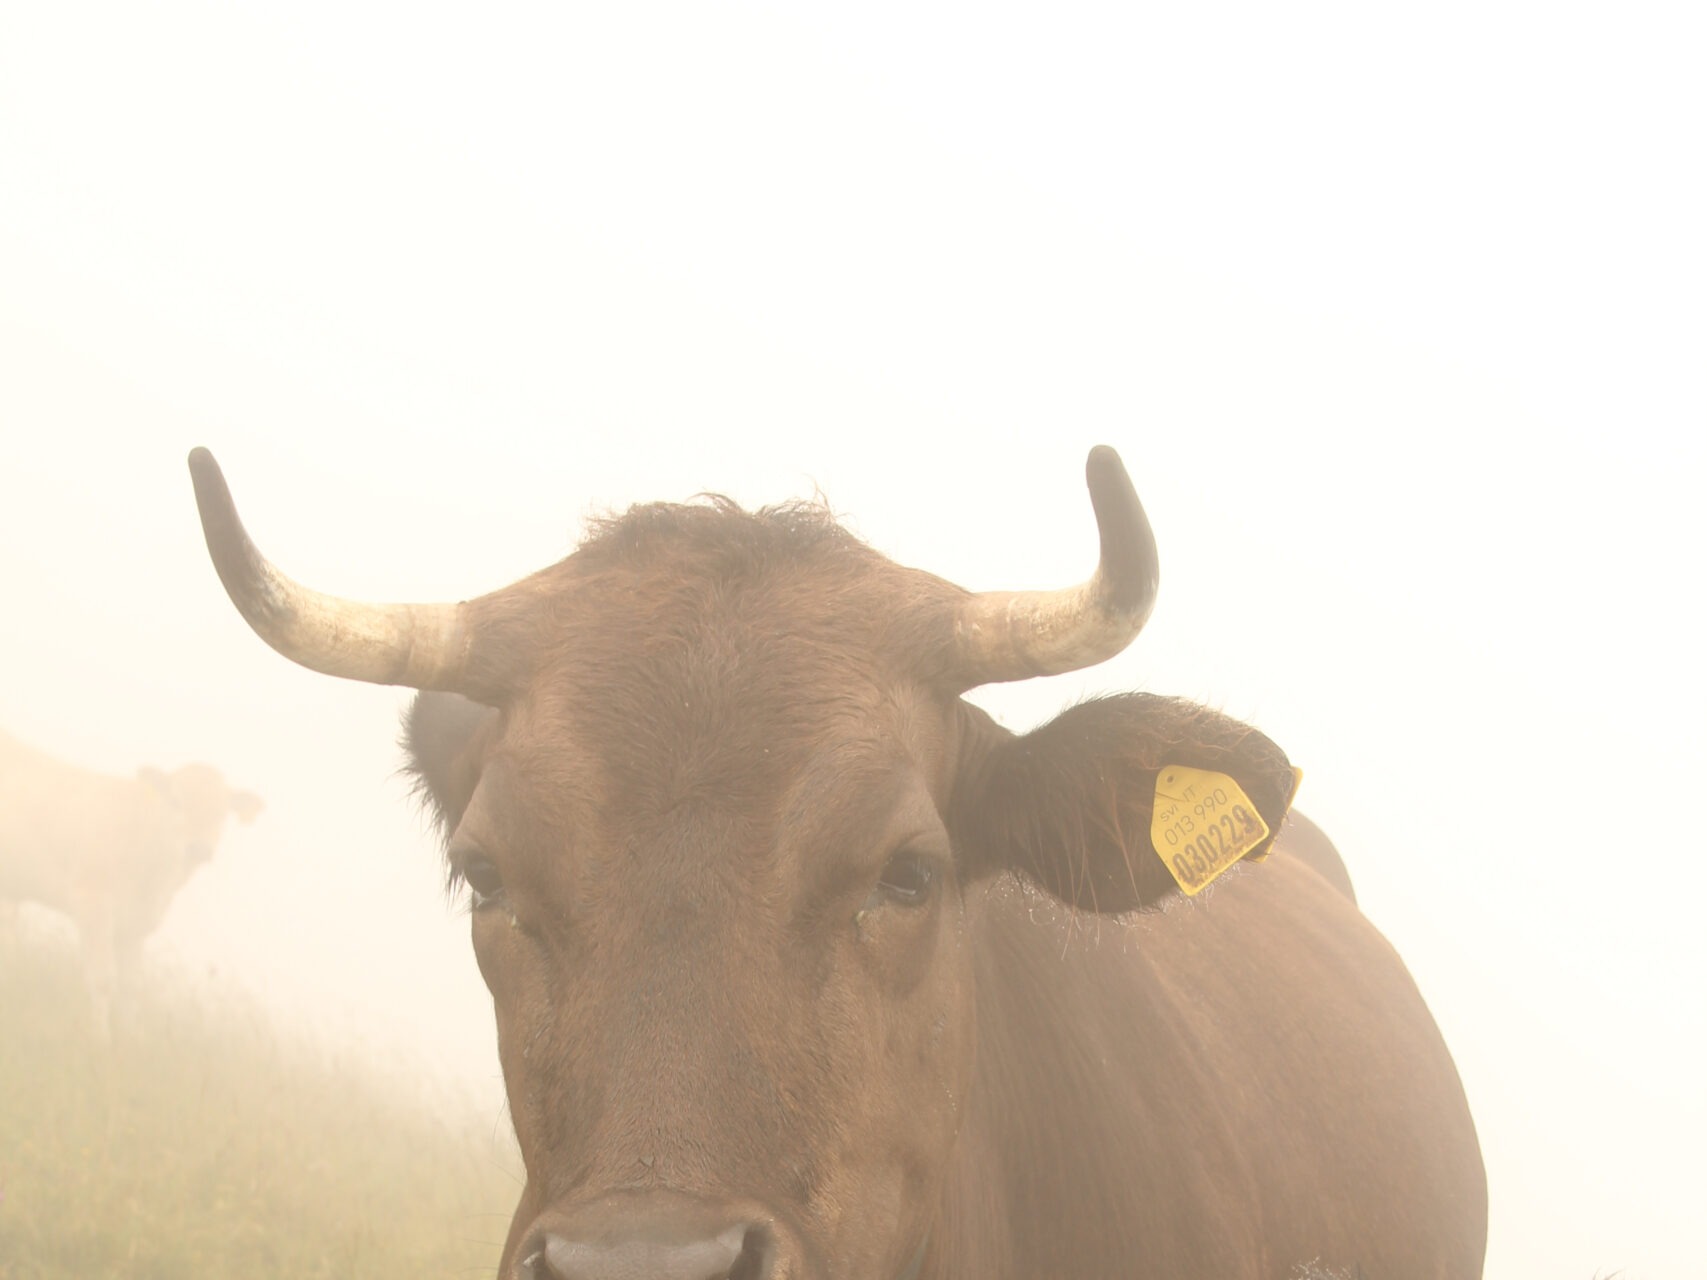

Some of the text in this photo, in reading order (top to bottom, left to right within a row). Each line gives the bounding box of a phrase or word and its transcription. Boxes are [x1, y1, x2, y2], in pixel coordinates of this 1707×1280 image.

[1164, 788, 1227, 846] 013 990
[1172, 804, 1254, 883] 030229
